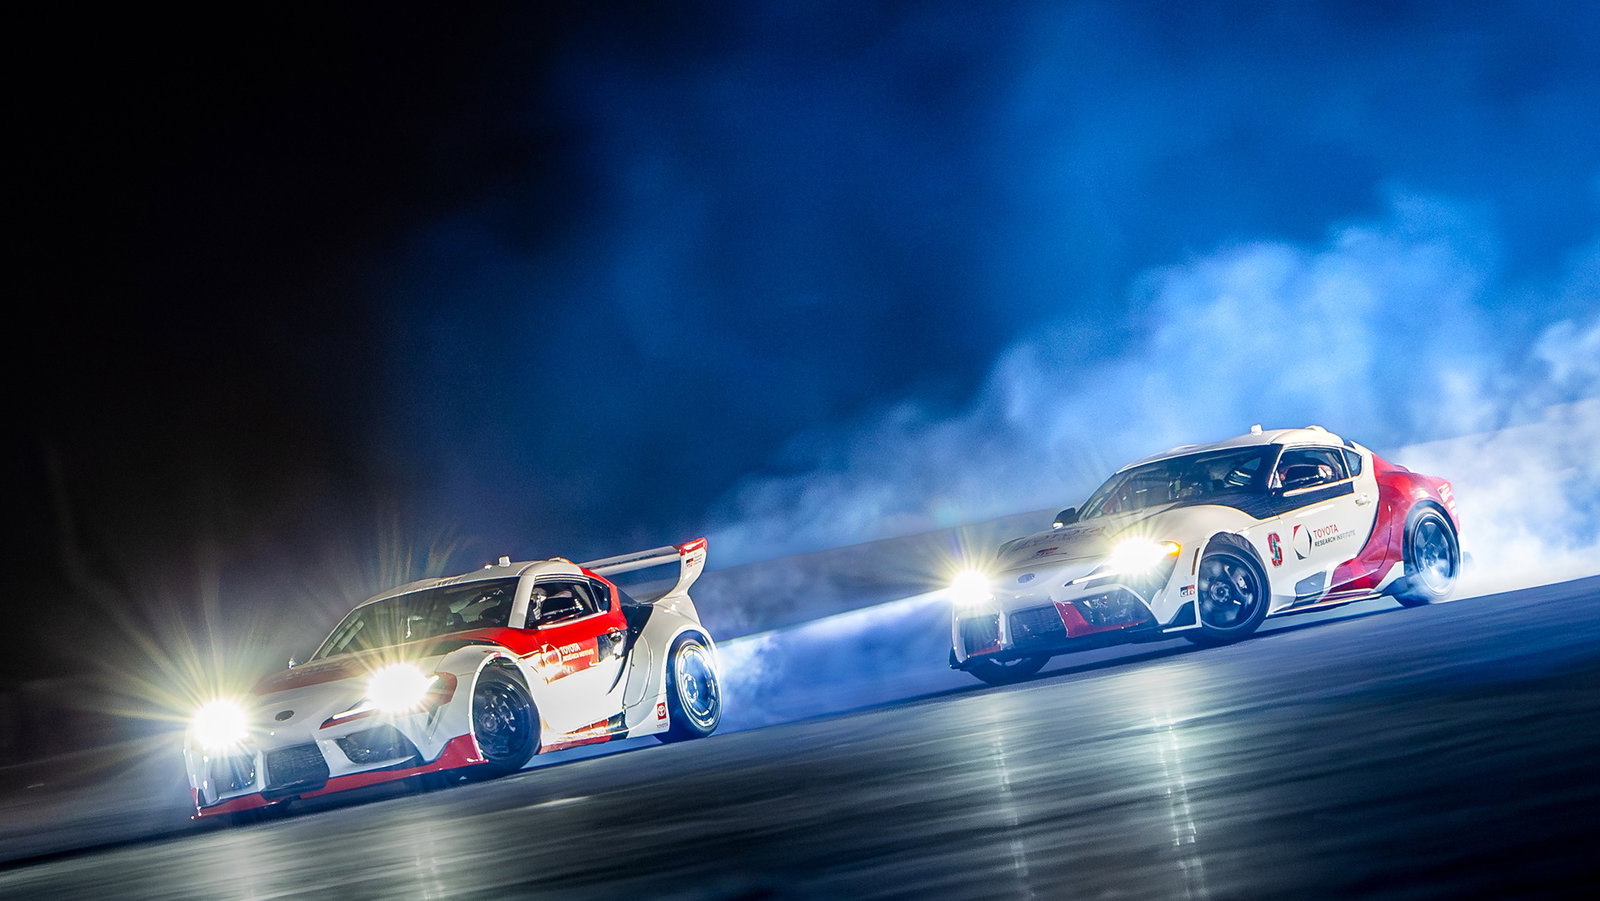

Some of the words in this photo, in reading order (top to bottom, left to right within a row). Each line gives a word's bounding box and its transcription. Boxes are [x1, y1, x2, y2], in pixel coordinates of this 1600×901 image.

[1313, 524, 1339, 539] TOYOTA
[1314, 537, 1336, 547] RESEARCH
[559, 643, 581, 655] TOYOTA
